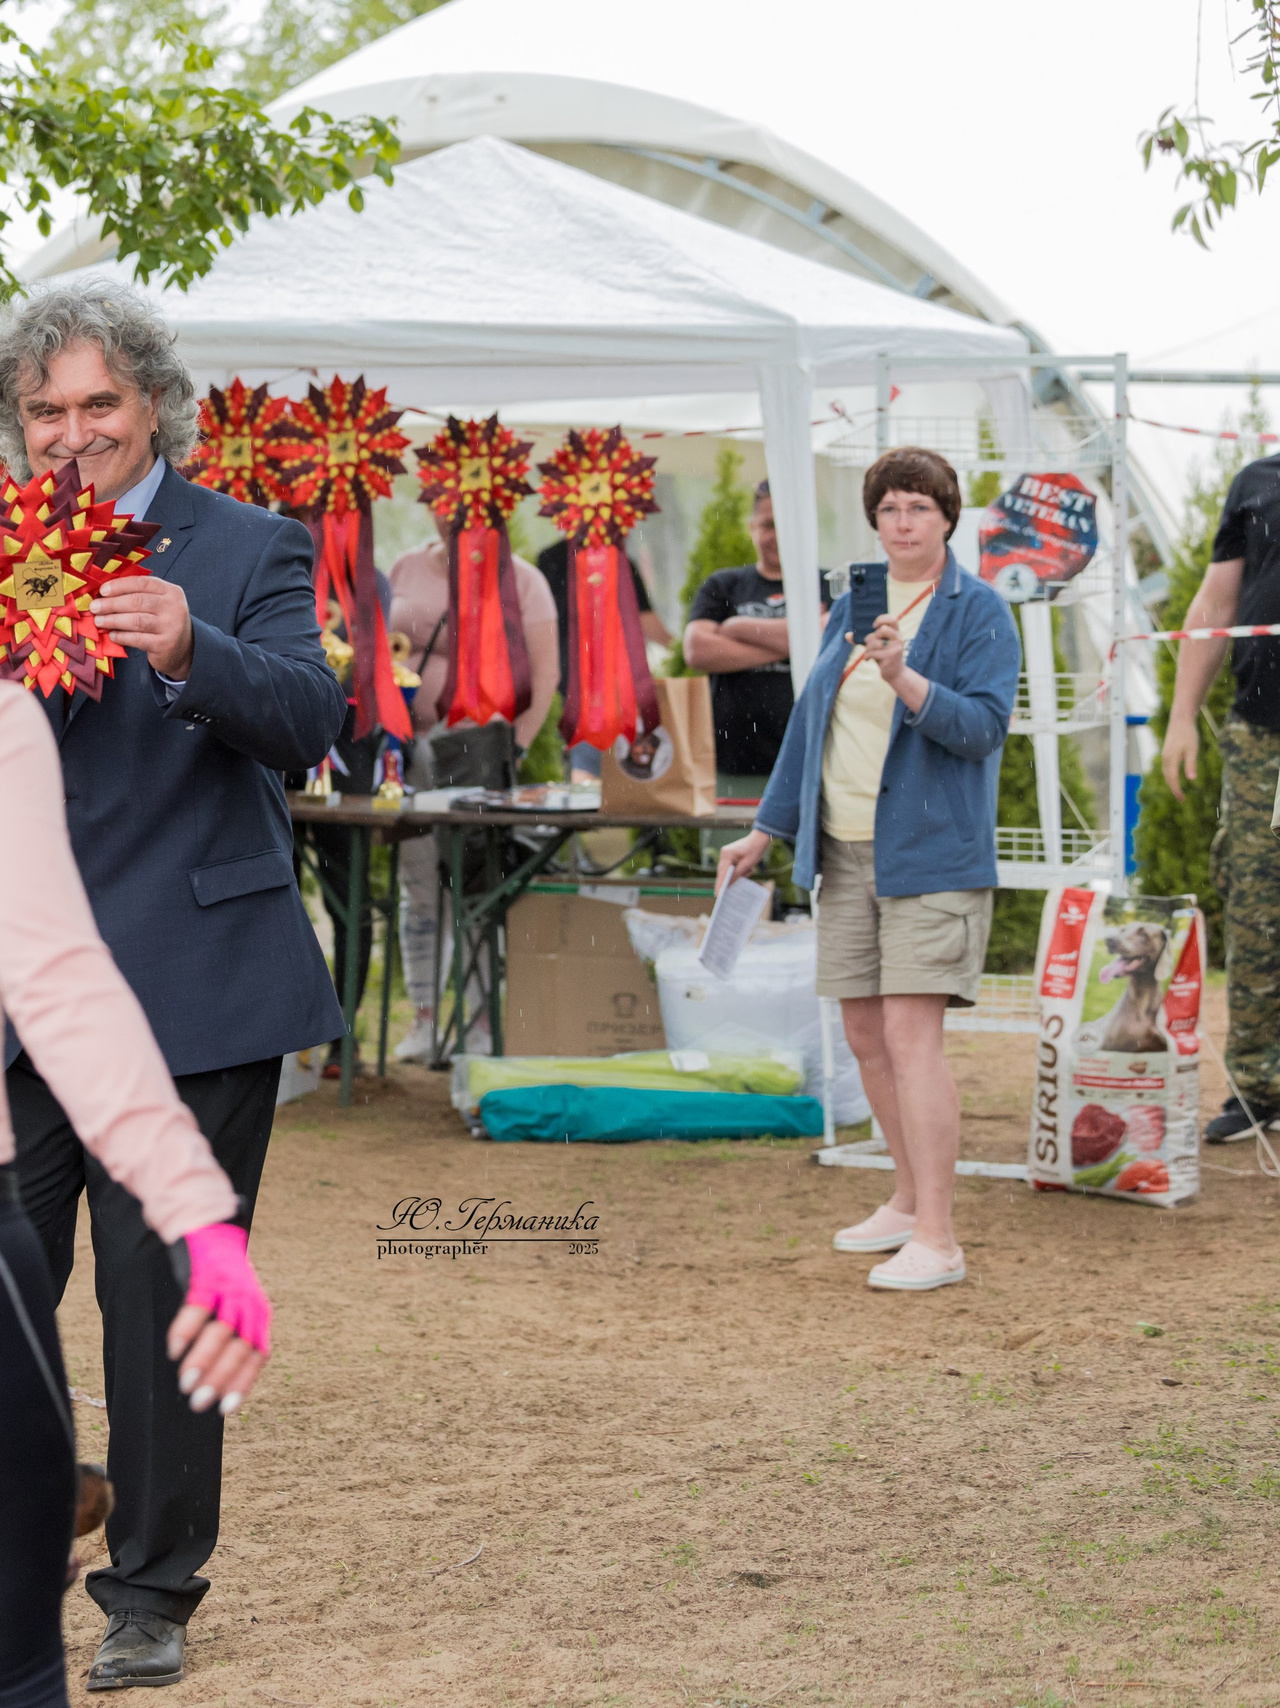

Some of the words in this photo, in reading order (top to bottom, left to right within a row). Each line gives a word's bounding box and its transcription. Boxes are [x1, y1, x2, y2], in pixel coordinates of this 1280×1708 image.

[1003, 492, 1091, 533] VETERAN
[1020, 477, 1094, 513] BEST
[1034, 1014, 1064, 1166] SIRIUS
